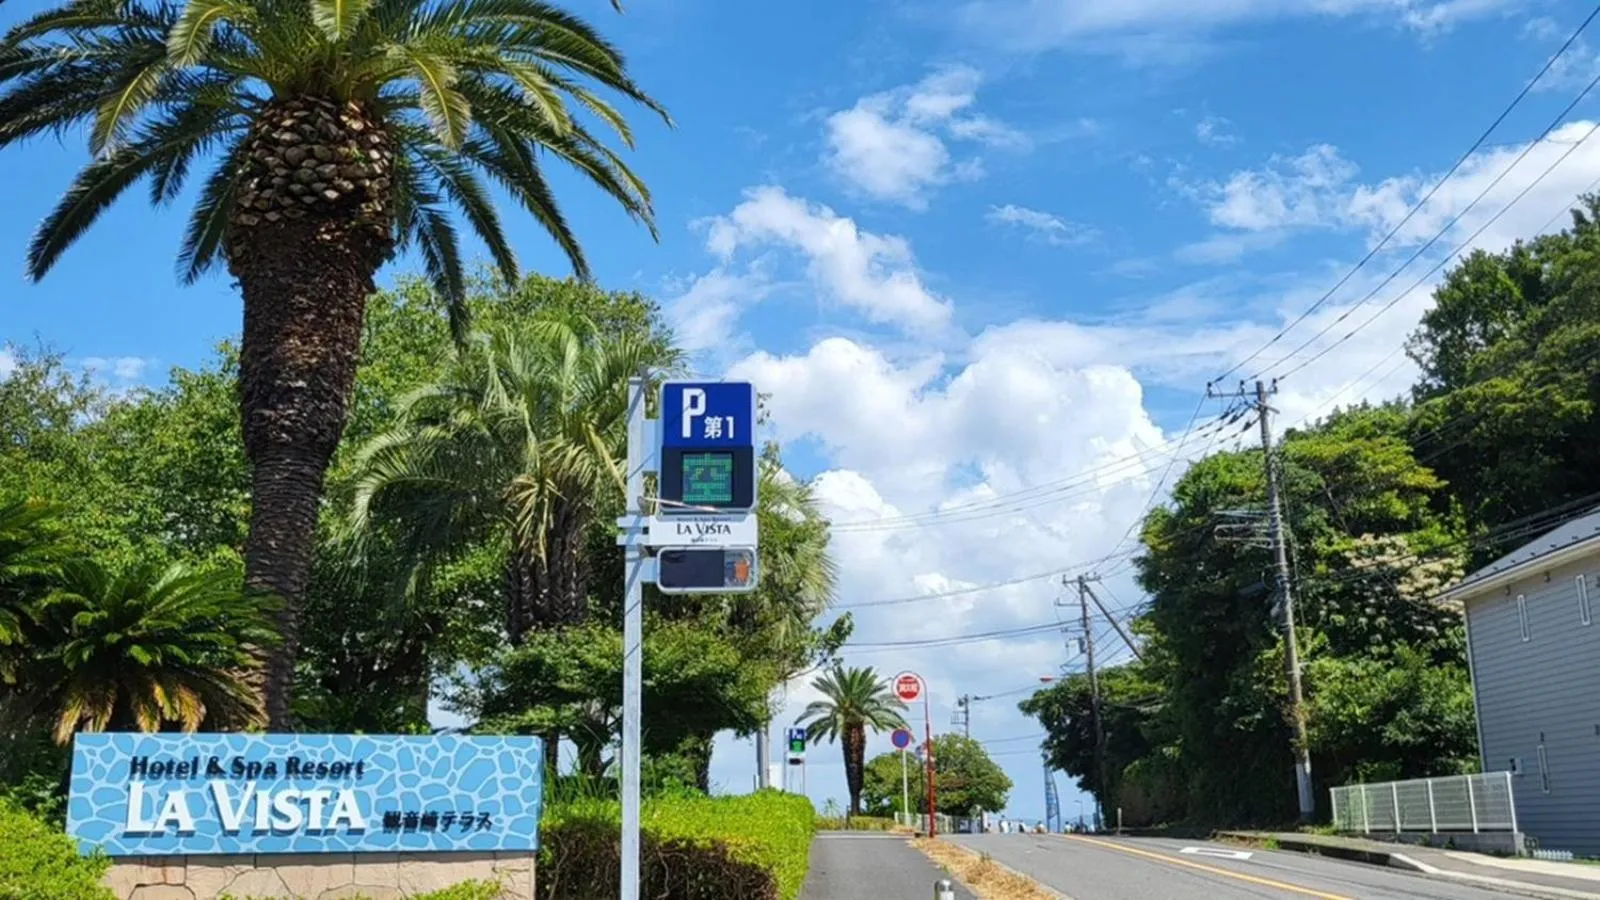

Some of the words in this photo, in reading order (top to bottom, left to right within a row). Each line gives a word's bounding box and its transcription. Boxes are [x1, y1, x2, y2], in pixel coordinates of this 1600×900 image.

[682, 388, 706, 438] P
[704, 416, 734, 438] 第1
[676, 523, 692, 535] LA
[695, 523, 732, 536] VISTA
[130, 756, 199, 779] Hotel
[205, 756, 227, 779] &
[230, 756, 278, 780] Spa
[285, 756, 366, 780] Resort
[122, 780, 197, 838] LA
[208, 780, 366, 838] VISTA
